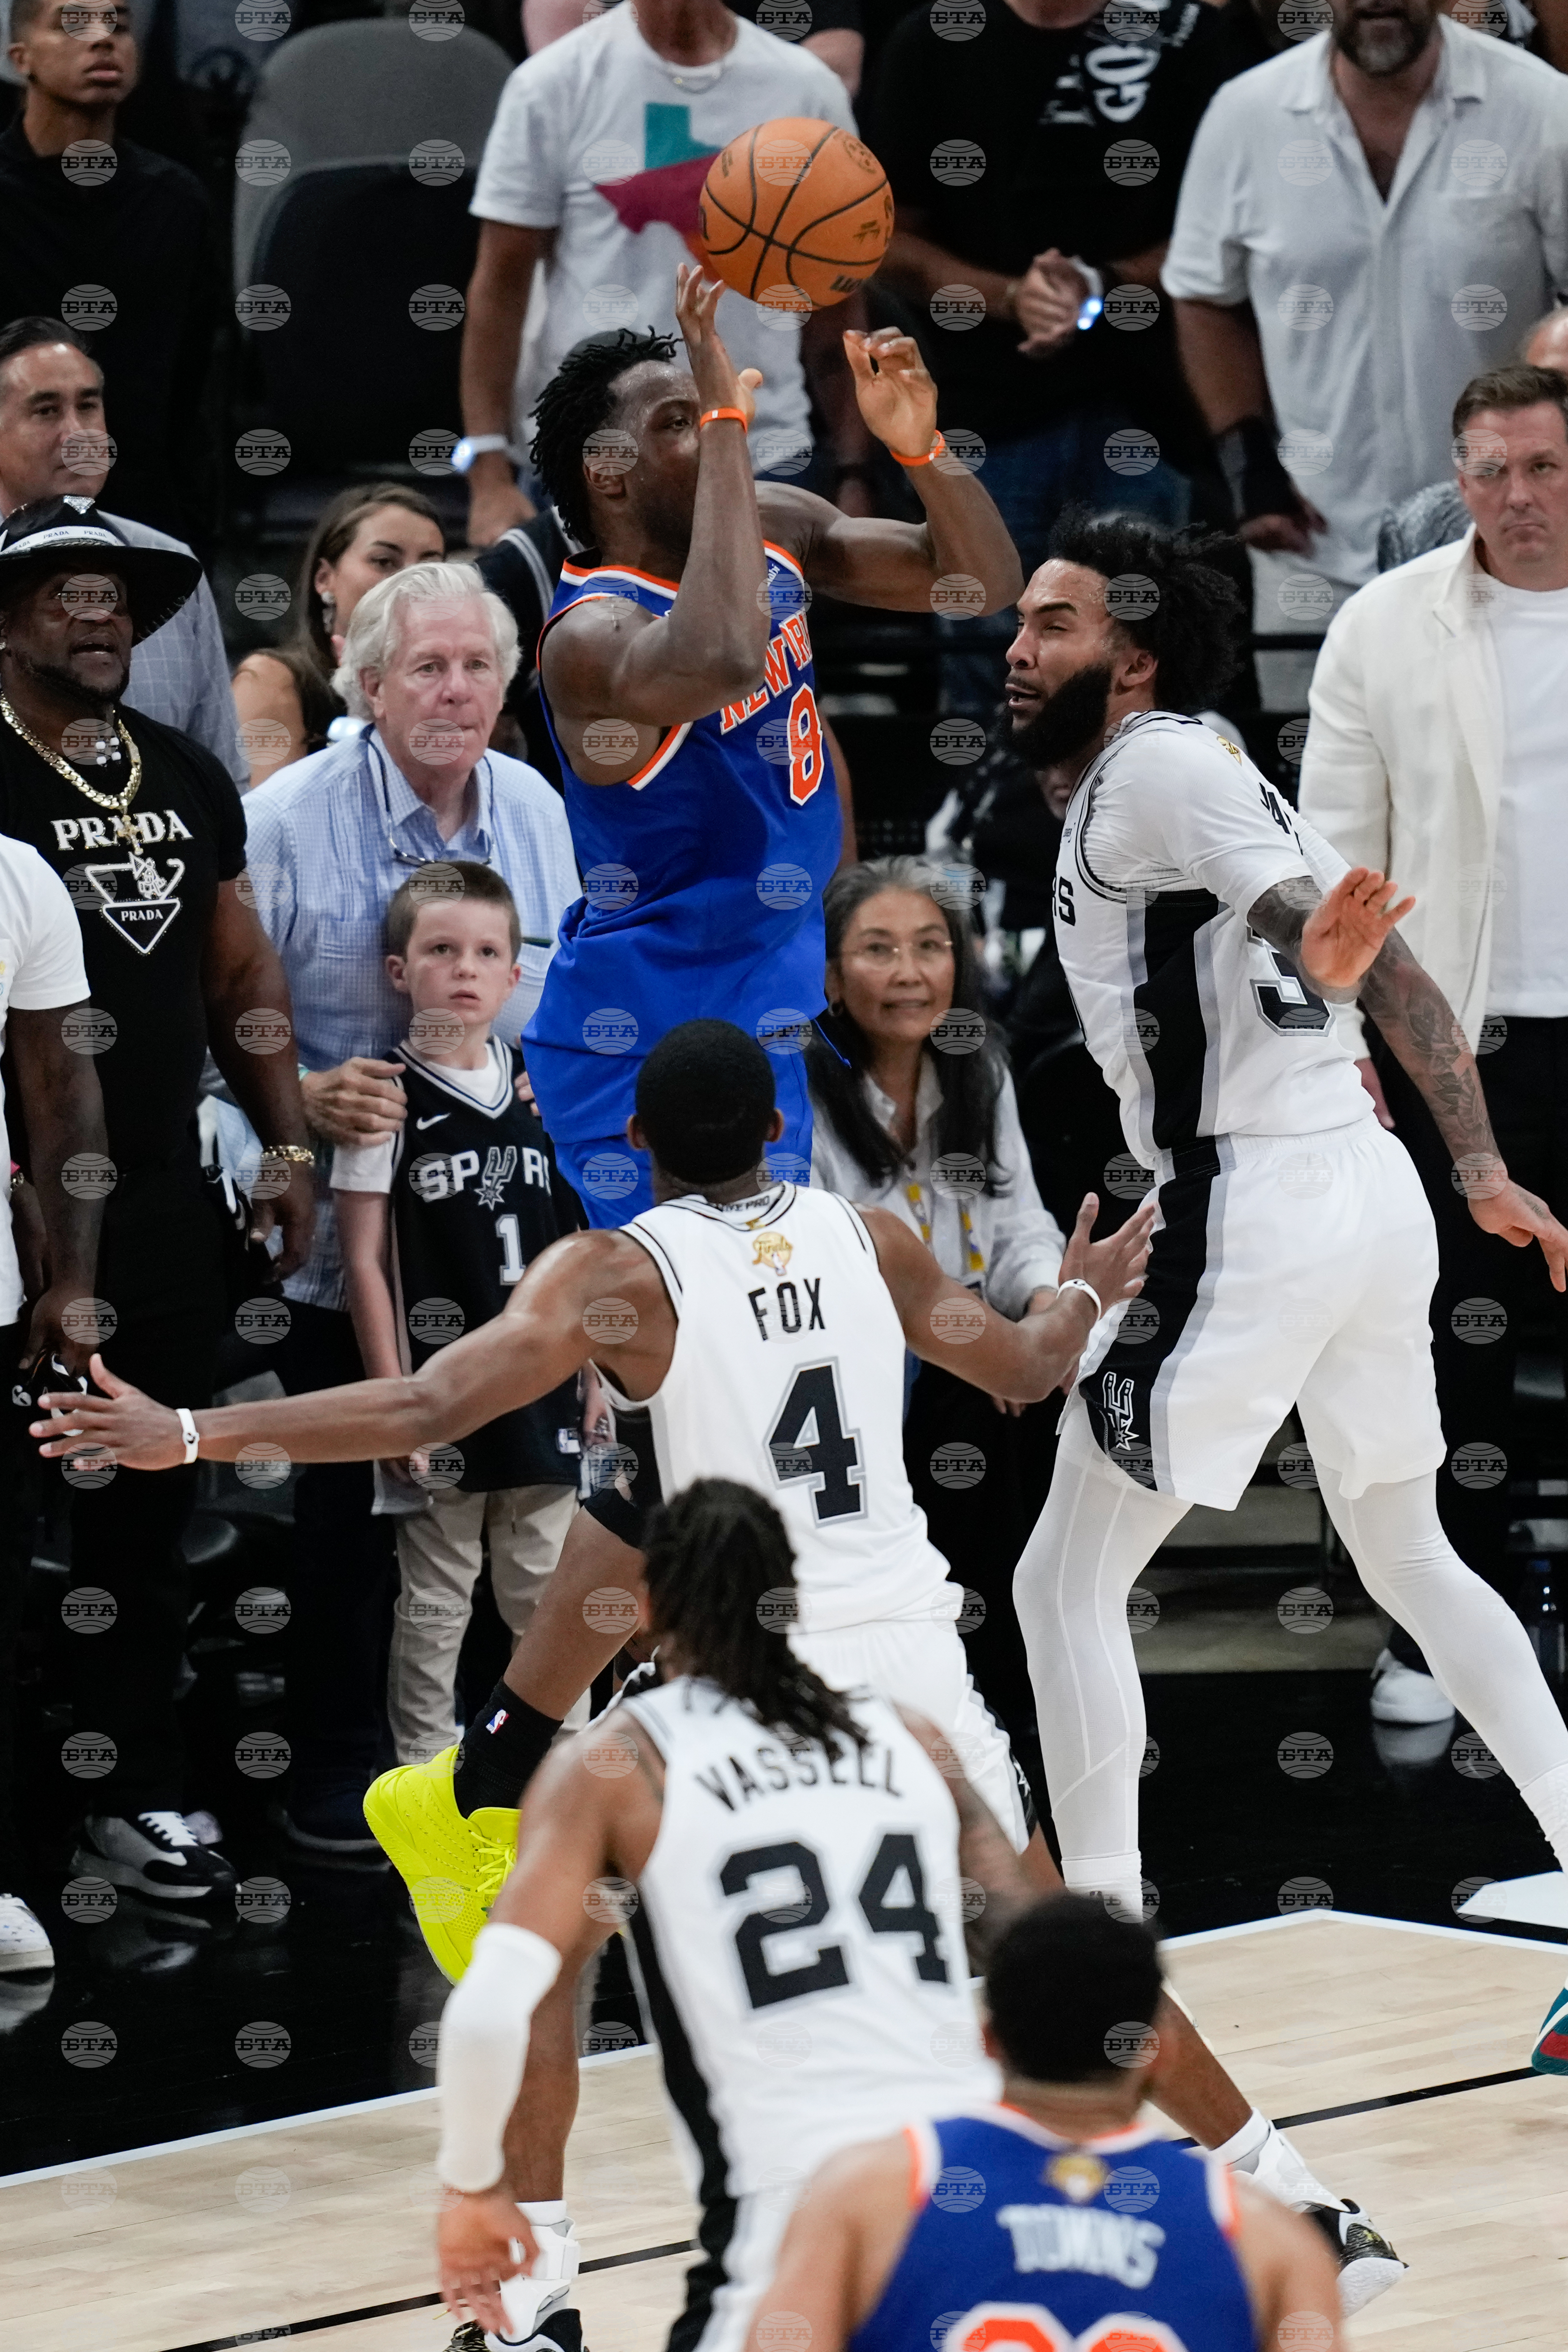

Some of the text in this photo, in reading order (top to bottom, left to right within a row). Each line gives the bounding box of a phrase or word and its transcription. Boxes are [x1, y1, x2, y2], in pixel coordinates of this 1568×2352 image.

[43, 530, 69, 539] PRADA
[84, 530, 107, 538] PRADA
[787, 682, 824, 806] 8
[121, 909, 164, 922] PRADA
[495, 1214, 526, 1286] 1
[748, 1277, 826, 1342] FOX
[763, 1356, 869, 1528] 4
[694, 1743, 902, 1811] VASSELL
[719, 1832, 954, 2010] 24
